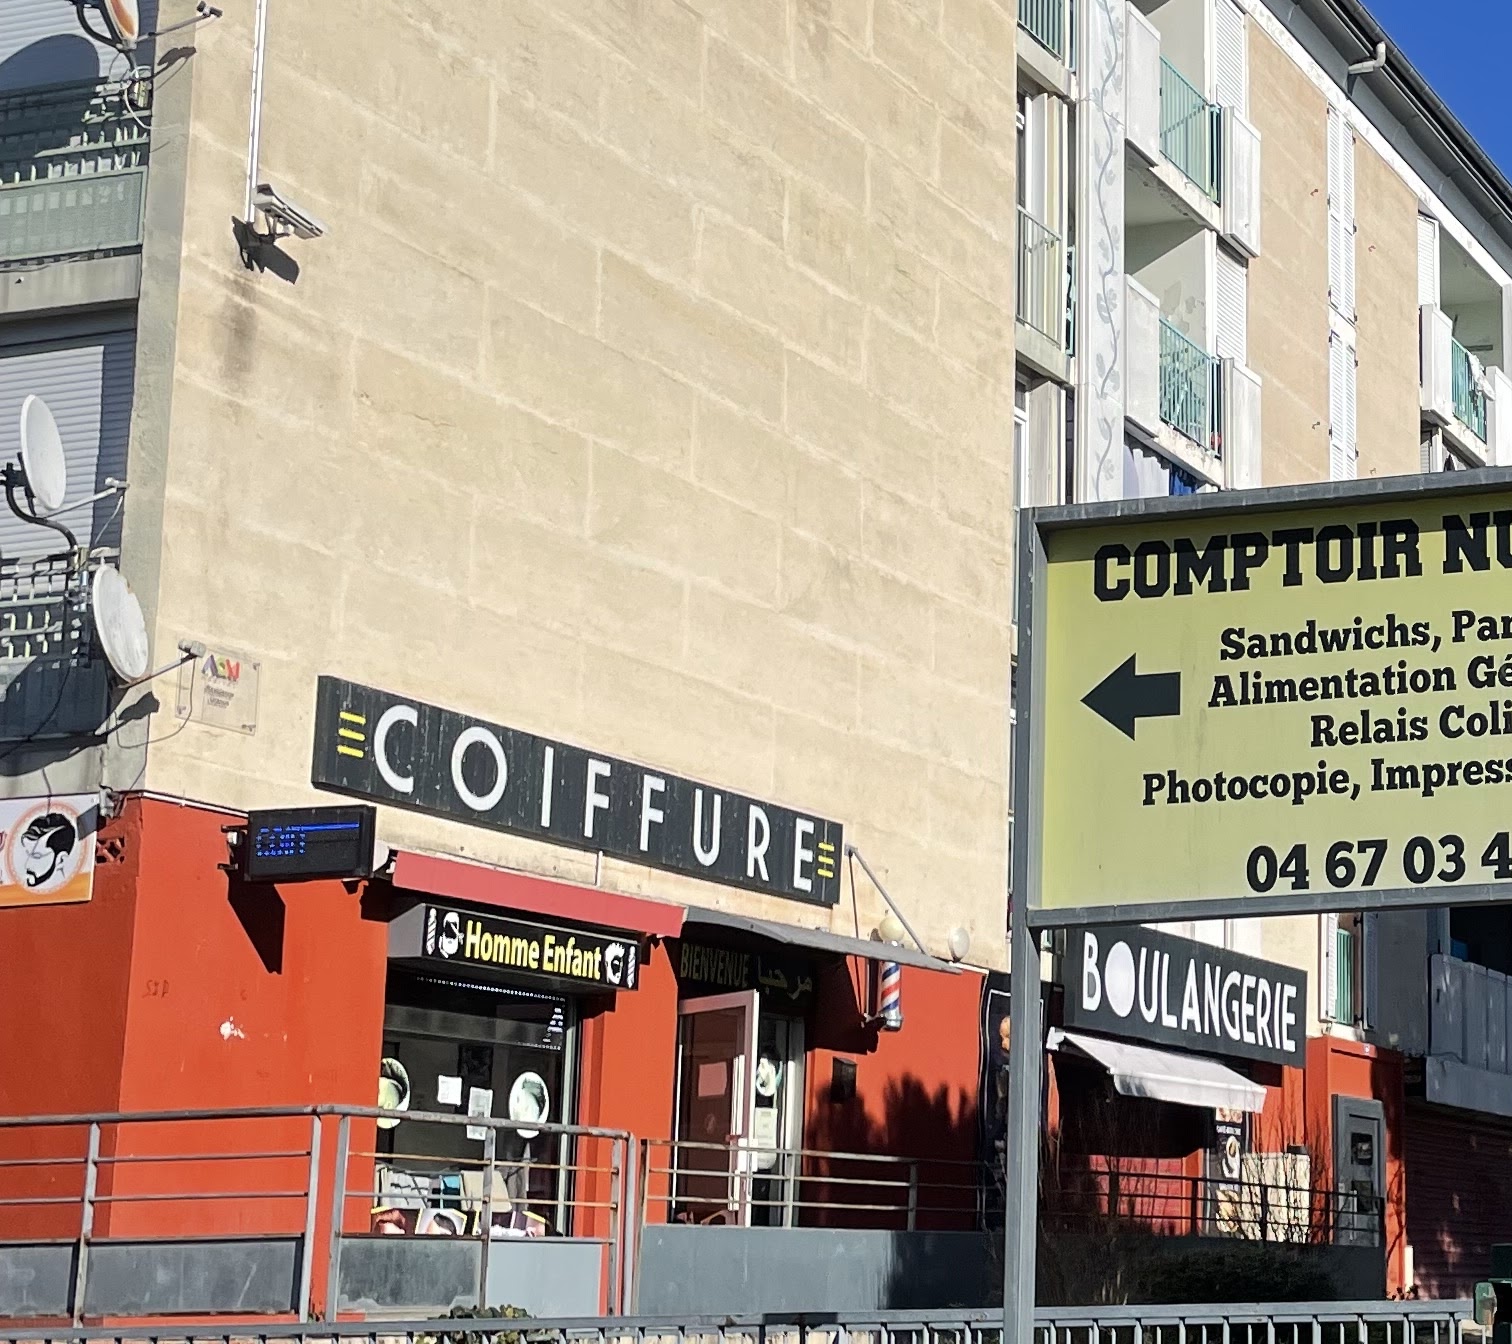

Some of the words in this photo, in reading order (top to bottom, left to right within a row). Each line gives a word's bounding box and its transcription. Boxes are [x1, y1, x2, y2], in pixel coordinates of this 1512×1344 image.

[1093, 517, 1423, 602] COMPTOIR
[1219, 614, 1442, 662] Sandwichs,
[1207, 664, 1457, 709] Alimentation
[1310, 707, 1430, 749] Relais
[373, 704, 814, 893] COIFFURE
[1142, 764, 1361, 806] Photocopie,
[1246, 843, 1310, 894] 04
[1325, 838, 1389, 889] 67
[1402, 834, 1467, 885] 03
[464, 919, 540, 970] Homme
[541, 934, 602, 981] Enfant
[680, 942, 751, 989] BIENVENUE
[757, 955, 813, 1000] مرحبا
[1082, 931, 1298, 1053] BOULANGERIE
